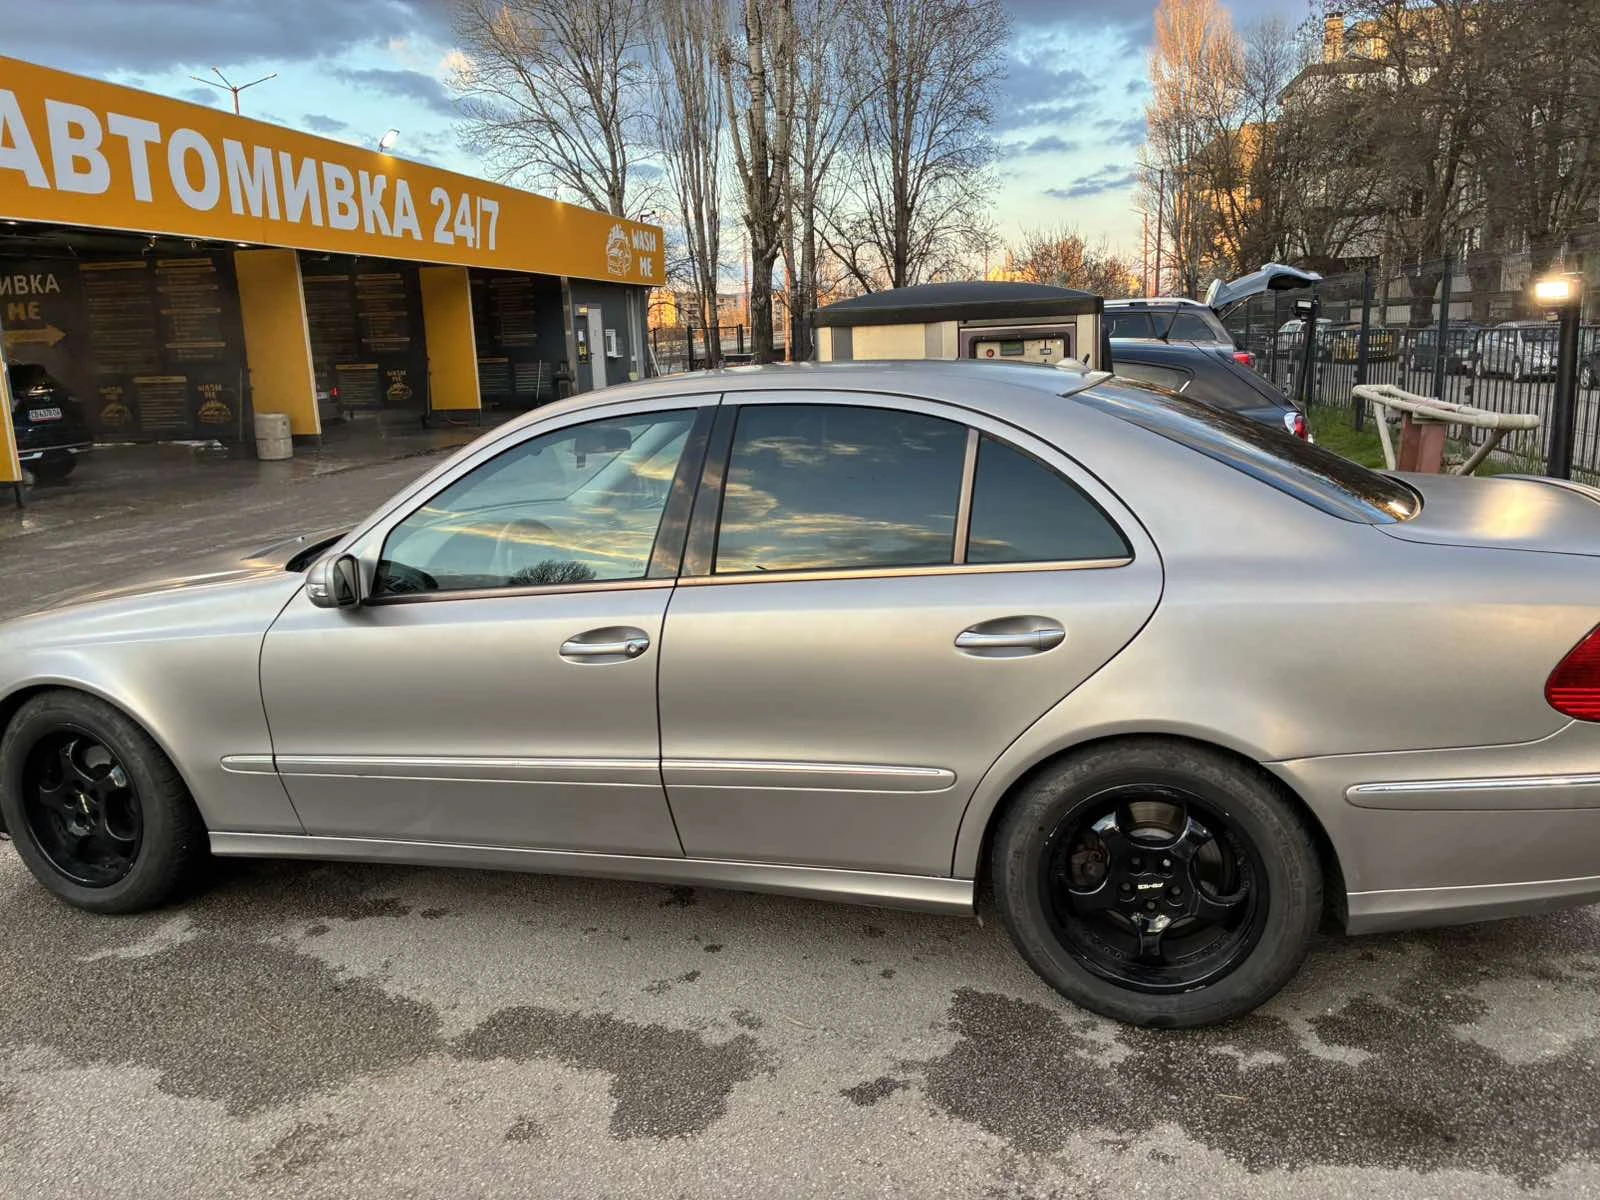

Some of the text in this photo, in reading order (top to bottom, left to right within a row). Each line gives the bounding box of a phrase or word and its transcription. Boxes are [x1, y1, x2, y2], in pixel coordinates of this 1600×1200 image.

[0, 89, 421, 241] АВТОМИВКА
[632, 228, 656, 253] WASH
[640, 256, 654, 278] ME
